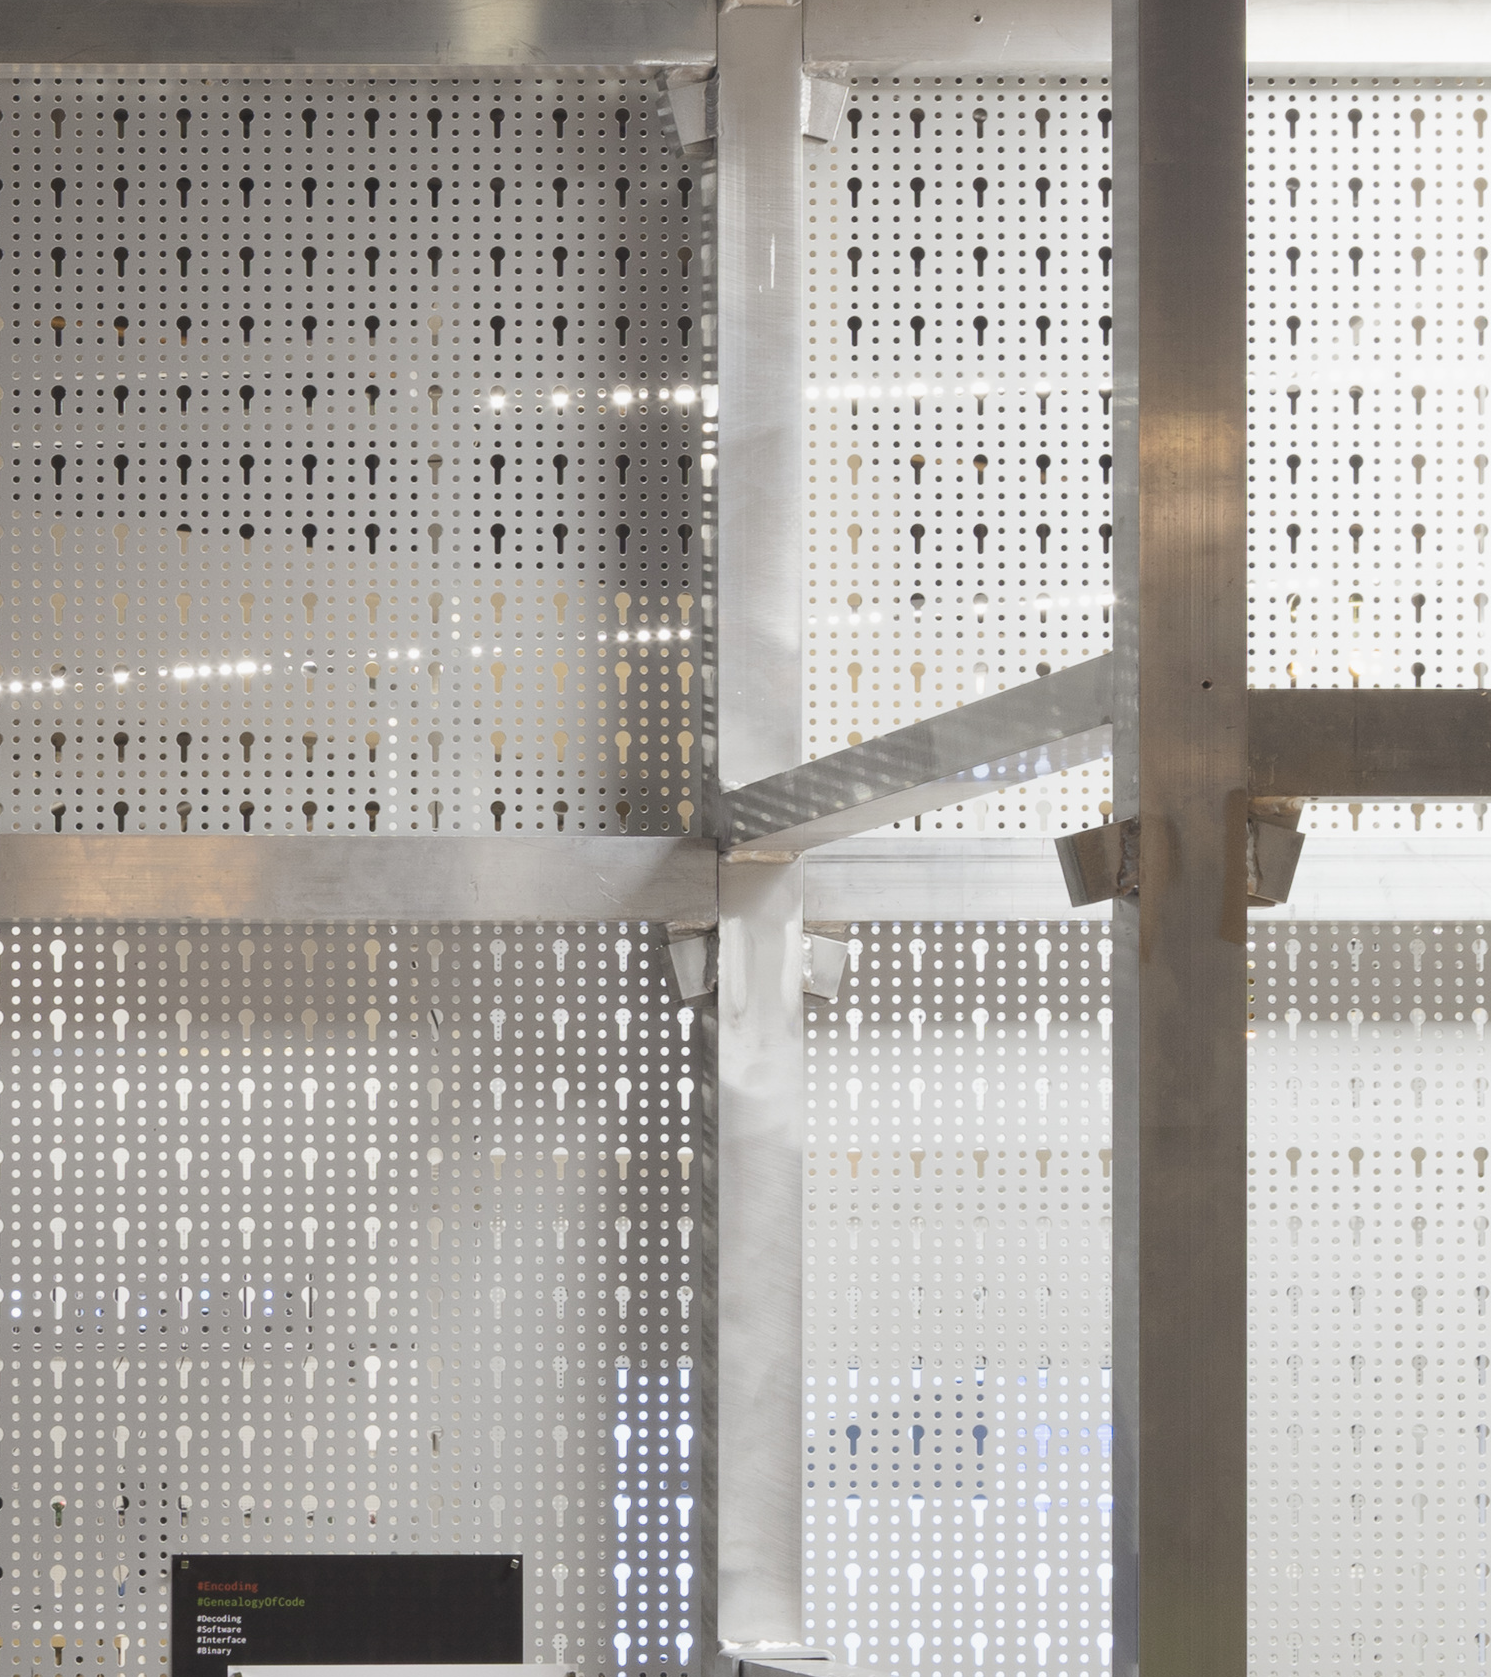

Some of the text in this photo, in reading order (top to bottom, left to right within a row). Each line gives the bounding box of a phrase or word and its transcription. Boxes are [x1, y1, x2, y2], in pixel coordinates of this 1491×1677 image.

[197, 1581, 258, 1593] #Encoding
[197, 1597, 305, 1608] #GenealogyOfCode
[197, 1615, 242, 1624] #Decoding
[197, 1625, 241, 1633] #Software
[197, 1636, 246, 1644] #Interface
[197, 1647, 231, 1656] #Binary
